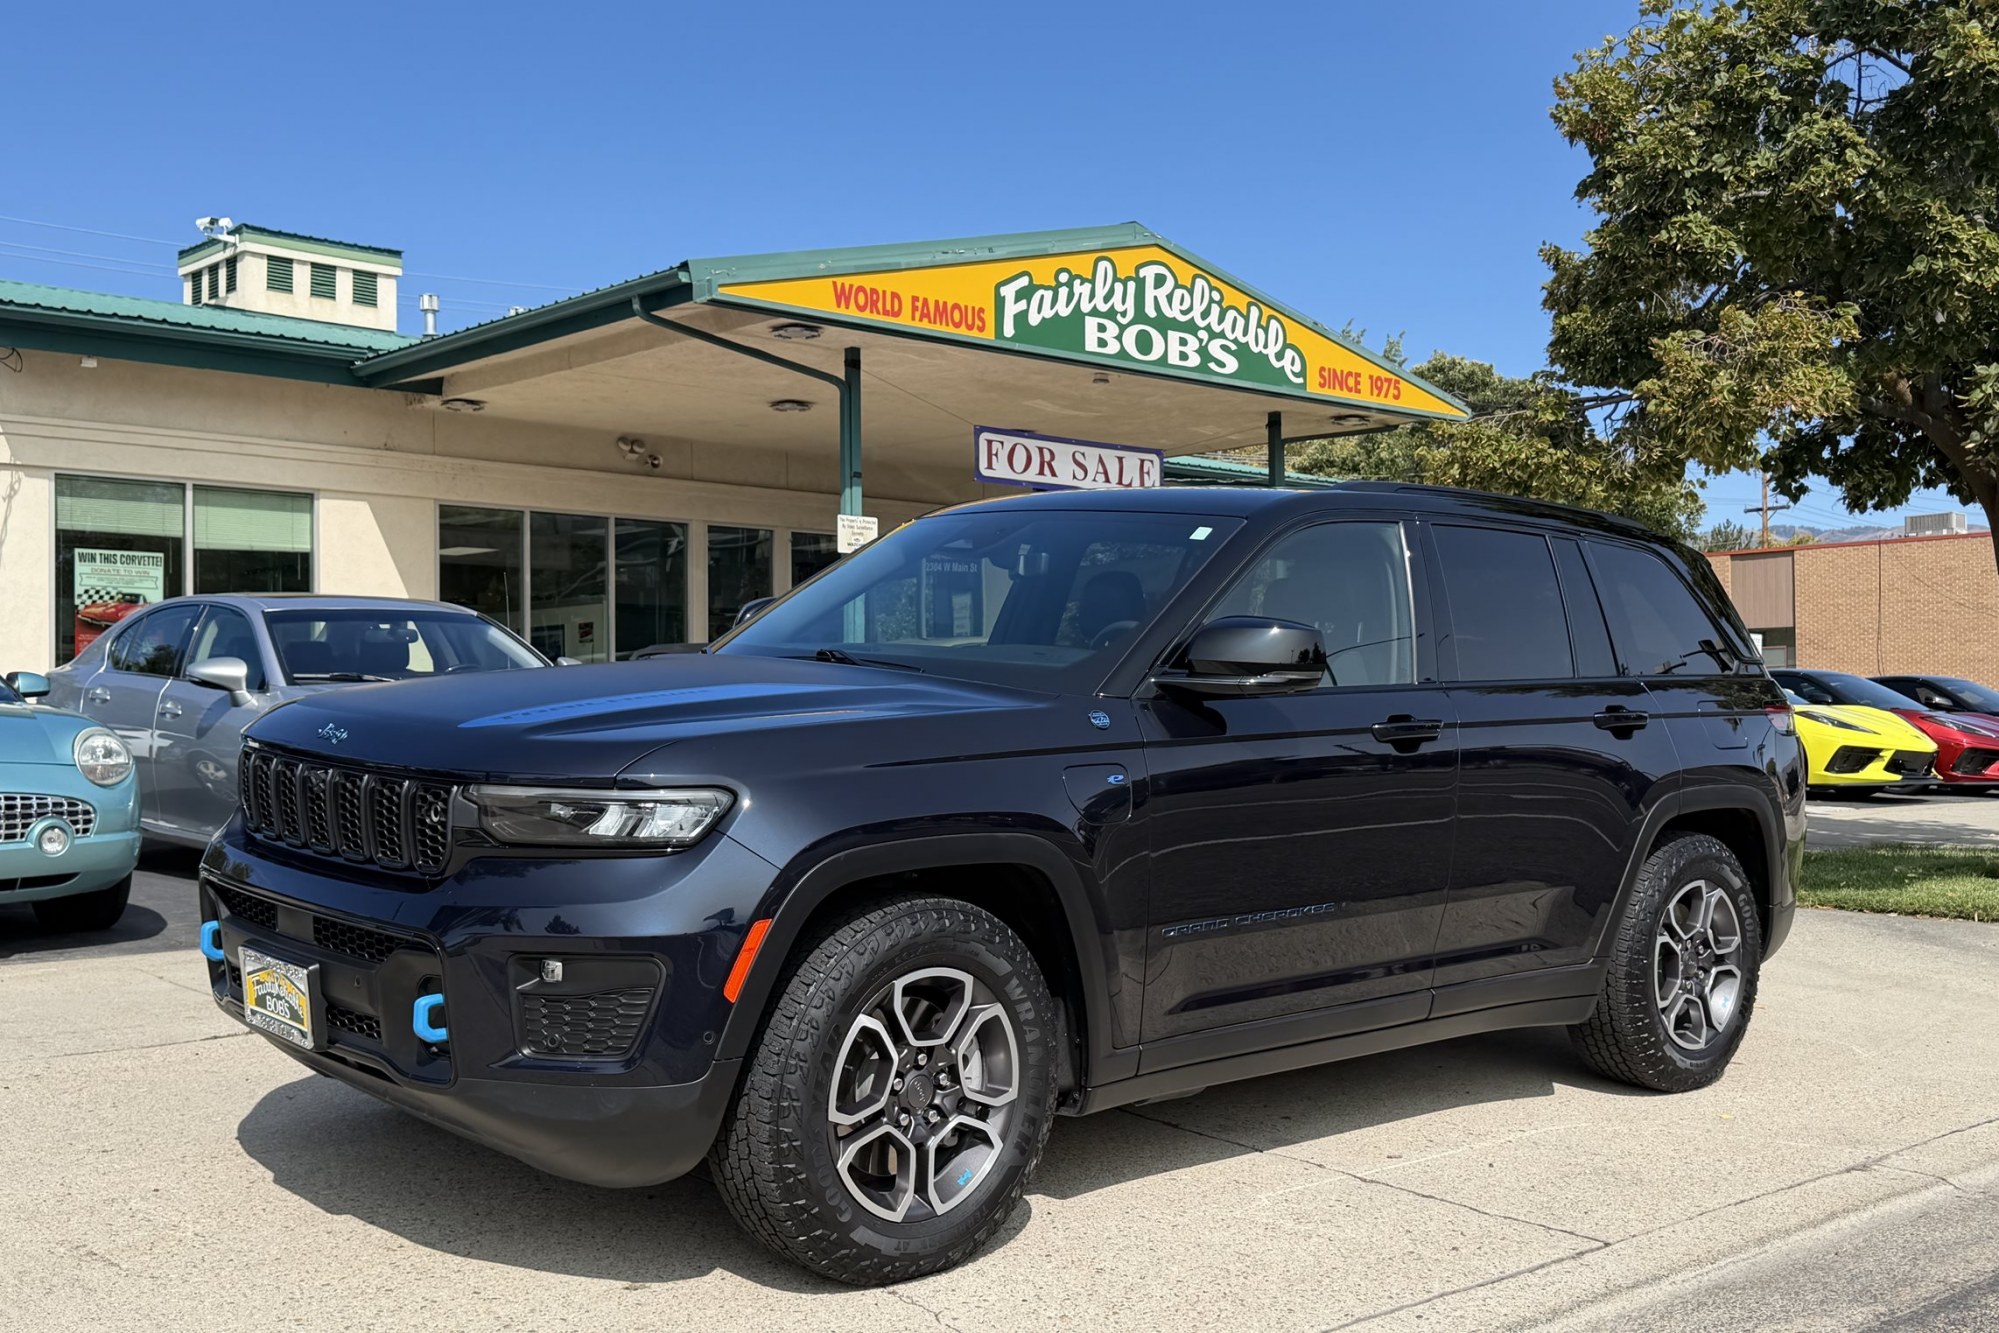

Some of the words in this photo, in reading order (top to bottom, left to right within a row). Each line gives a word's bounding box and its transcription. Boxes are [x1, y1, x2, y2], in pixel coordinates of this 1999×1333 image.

[832, 280, 903, 318] WORLD
[911, 295, 986, 333] FAMOUS
[1000, 260, 1136, 338] Fairly
[1139, 264, 1304, 384] Reliable
[1084, 315, 1239, 375] BOB'S
[1318, 366, 1361, 394] SINCE
[1368, 374, 1401, 400] 1975
[984, 438, 1058, 478] FOR
[1071, 450, 1156, 487] SALE
[77, 552, 97, 563] WIN
[99, 553, 118, 564] THIS
[120, 554, 162, 567] CORVETTE!
[943, 562, 950, 571] W
[952, 562, 968, 572] Main
[970, 562, 977, 572] St
[1161, 918, 1230, 937] GRAND
[1235, 902, 1336, 925] CHEROKEE
[1003, 975, 1046, 1157] WRANGLER
